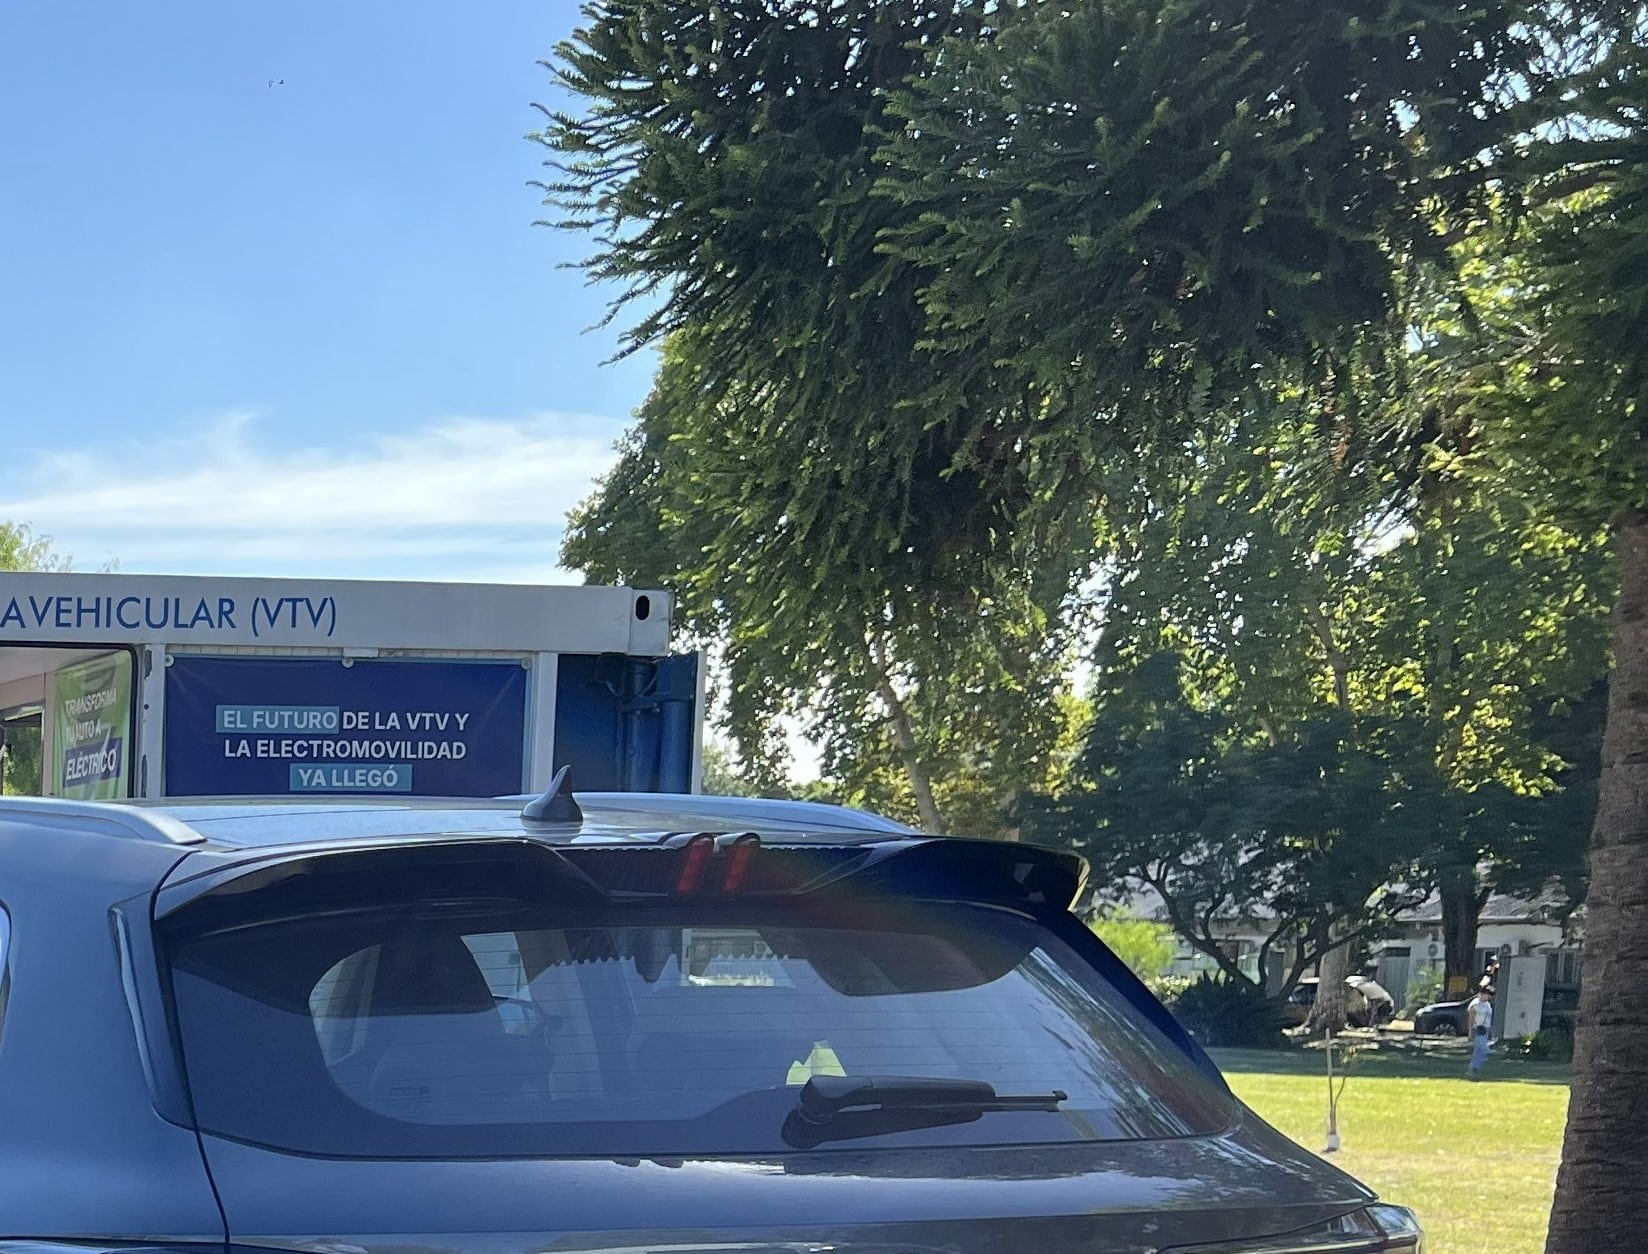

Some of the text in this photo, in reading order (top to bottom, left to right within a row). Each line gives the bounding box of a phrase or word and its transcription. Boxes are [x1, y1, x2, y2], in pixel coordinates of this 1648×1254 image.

[28, 595, 237, 630] VEHICULAR
[252, 597, 337, 638] (VTV)
[223, 710, 470, 732] EL FUTURO DE LA VTV Y
[224, 739, 467, 760] LA ELECTROMOVILIDAD
[65, 749, 117, 780] ELÉCTRICO
[298, 765, 398, 788] YA LLEGÓ
